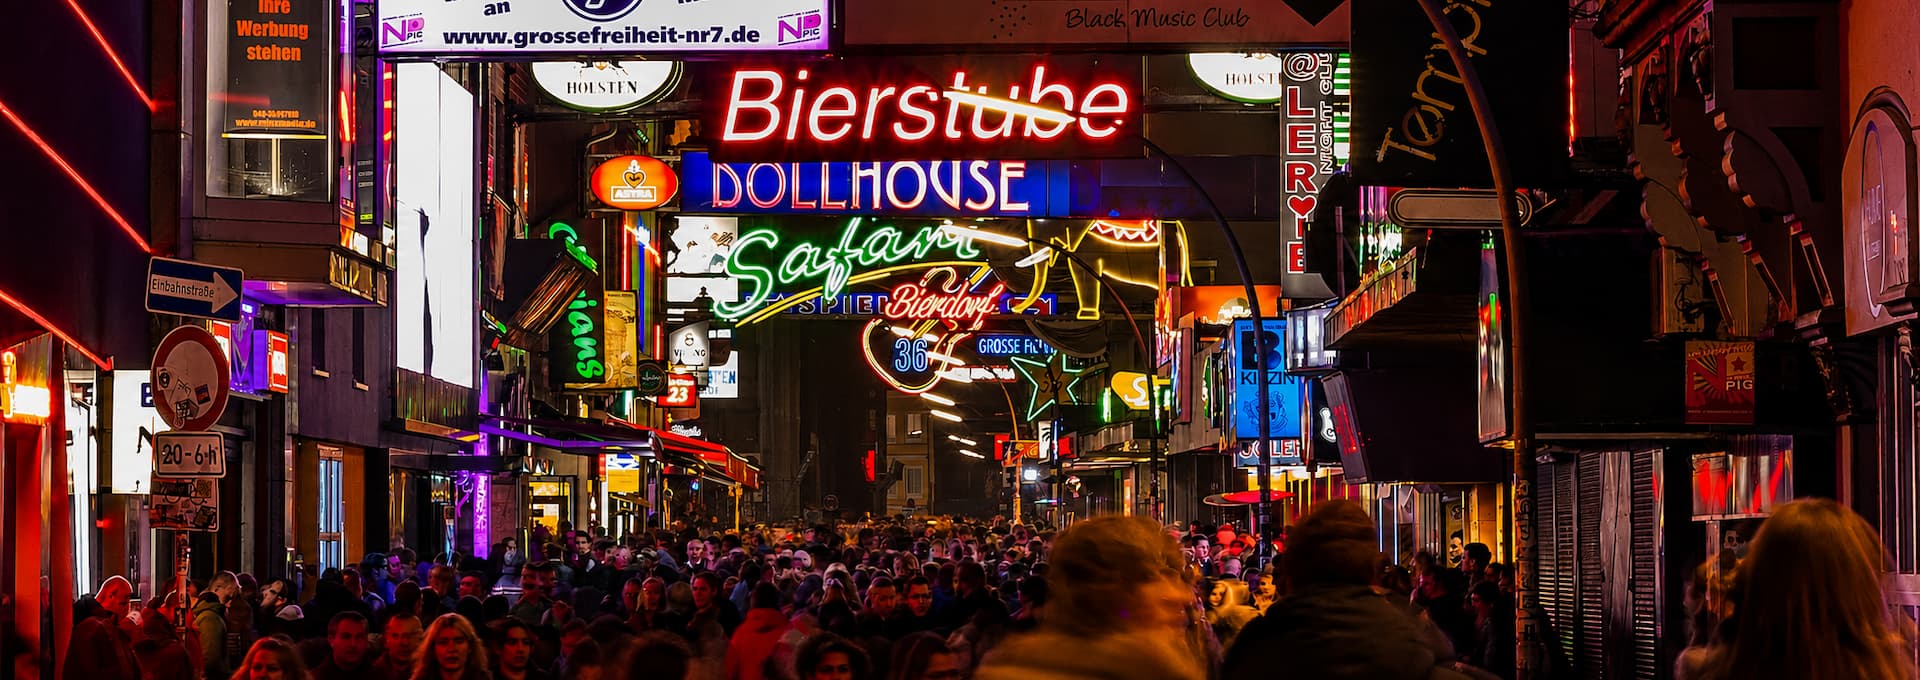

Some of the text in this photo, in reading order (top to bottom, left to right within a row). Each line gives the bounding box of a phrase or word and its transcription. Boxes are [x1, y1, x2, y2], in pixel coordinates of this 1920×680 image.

[1065, 7, 1250, 28] Black Music Club
[236, 20, 309, 40] Werbung
[443, 26, 760, 48] www.grossefreiheit-nr7.de
[246, 44, 301, 61] stehen
[567, 80, 637, 95] HOLSTEN
[1225, 72, 1282, 86] HOLST
[722, 65, 1128, 142] Bierstube
[711, 161, 1030, 213] DOLLHOUSE
[152, 278, 215, 298] Einbahnstraße
[885, 281, 1004, 331] Bierdorf
[894, 338, 928, 372] 36
[978, 338, 1021, 354] GROSSE
[667, 386, 690, 403] 23
[1726, 380, 1753, 391] PIG
